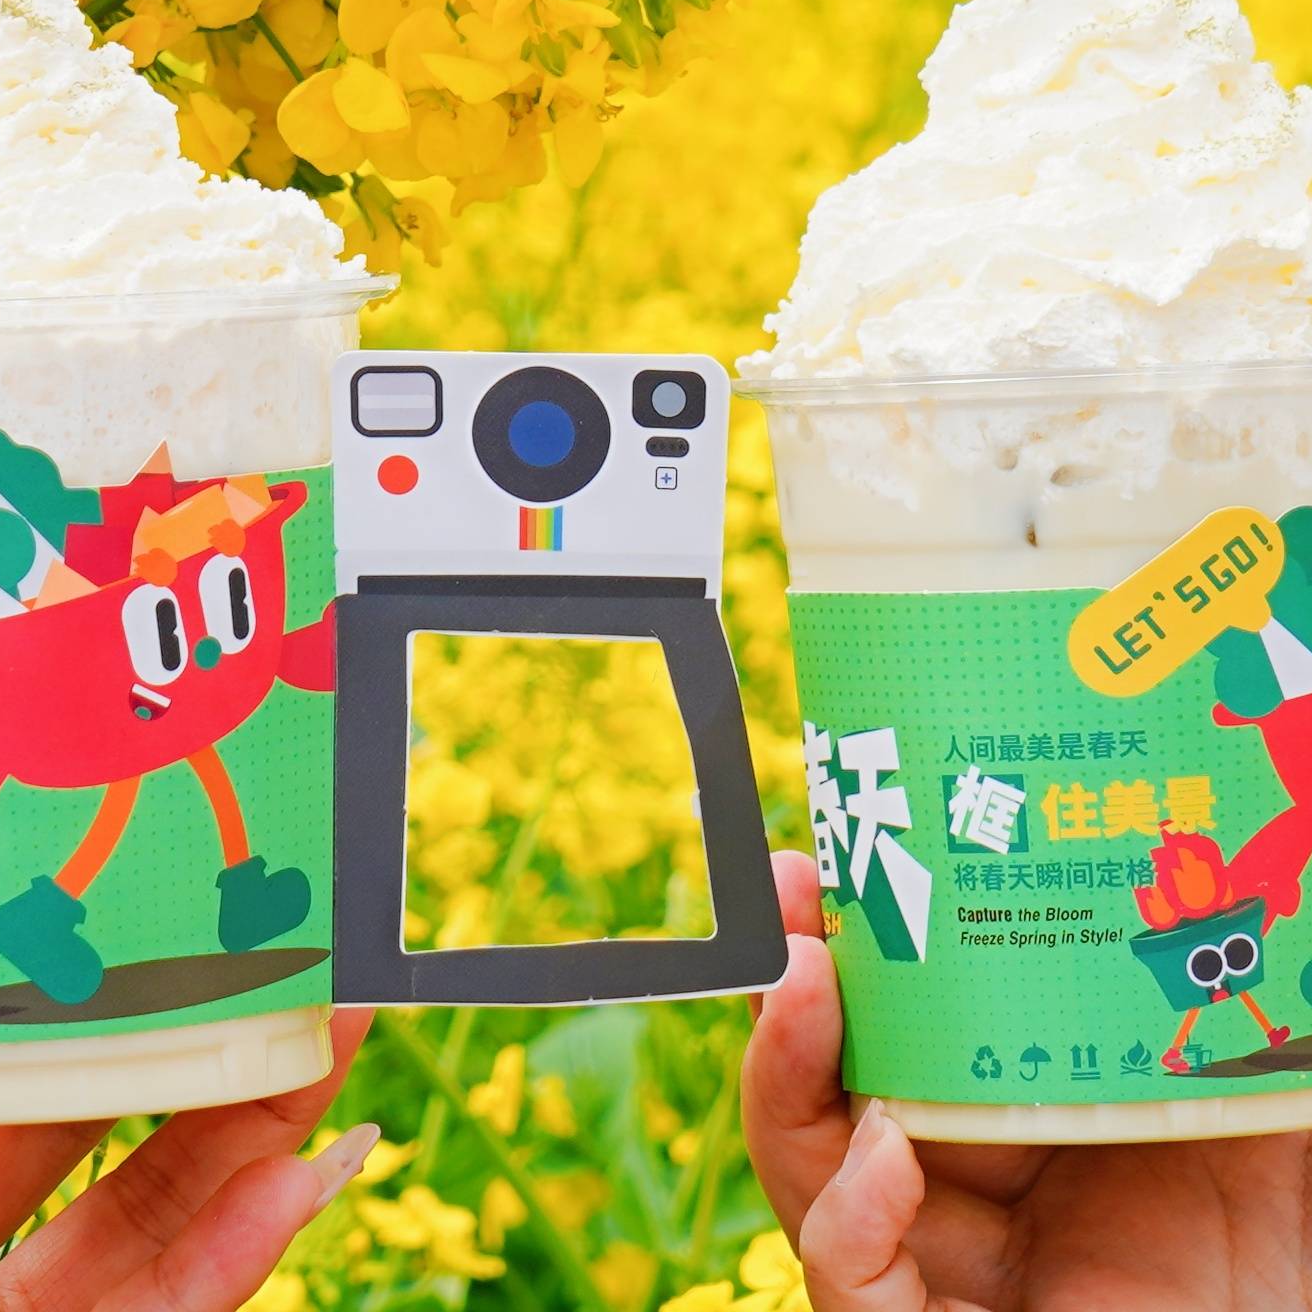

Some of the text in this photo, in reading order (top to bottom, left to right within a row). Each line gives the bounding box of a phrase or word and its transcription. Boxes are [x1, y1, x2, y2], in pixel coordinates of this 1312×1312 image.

[1093, 523, 1274, 676] LET'S GO!
[944, 730, 1148, 763] 人间最美是春天
[948, 764, 1217, 855] 框住美景
[953, 859, 1155, 892] 将春天瞬间定格
[957, 906, 1093, 924] Capture the Bloom
[960, 928, 1123, 948] Freeze Spring in Style!
